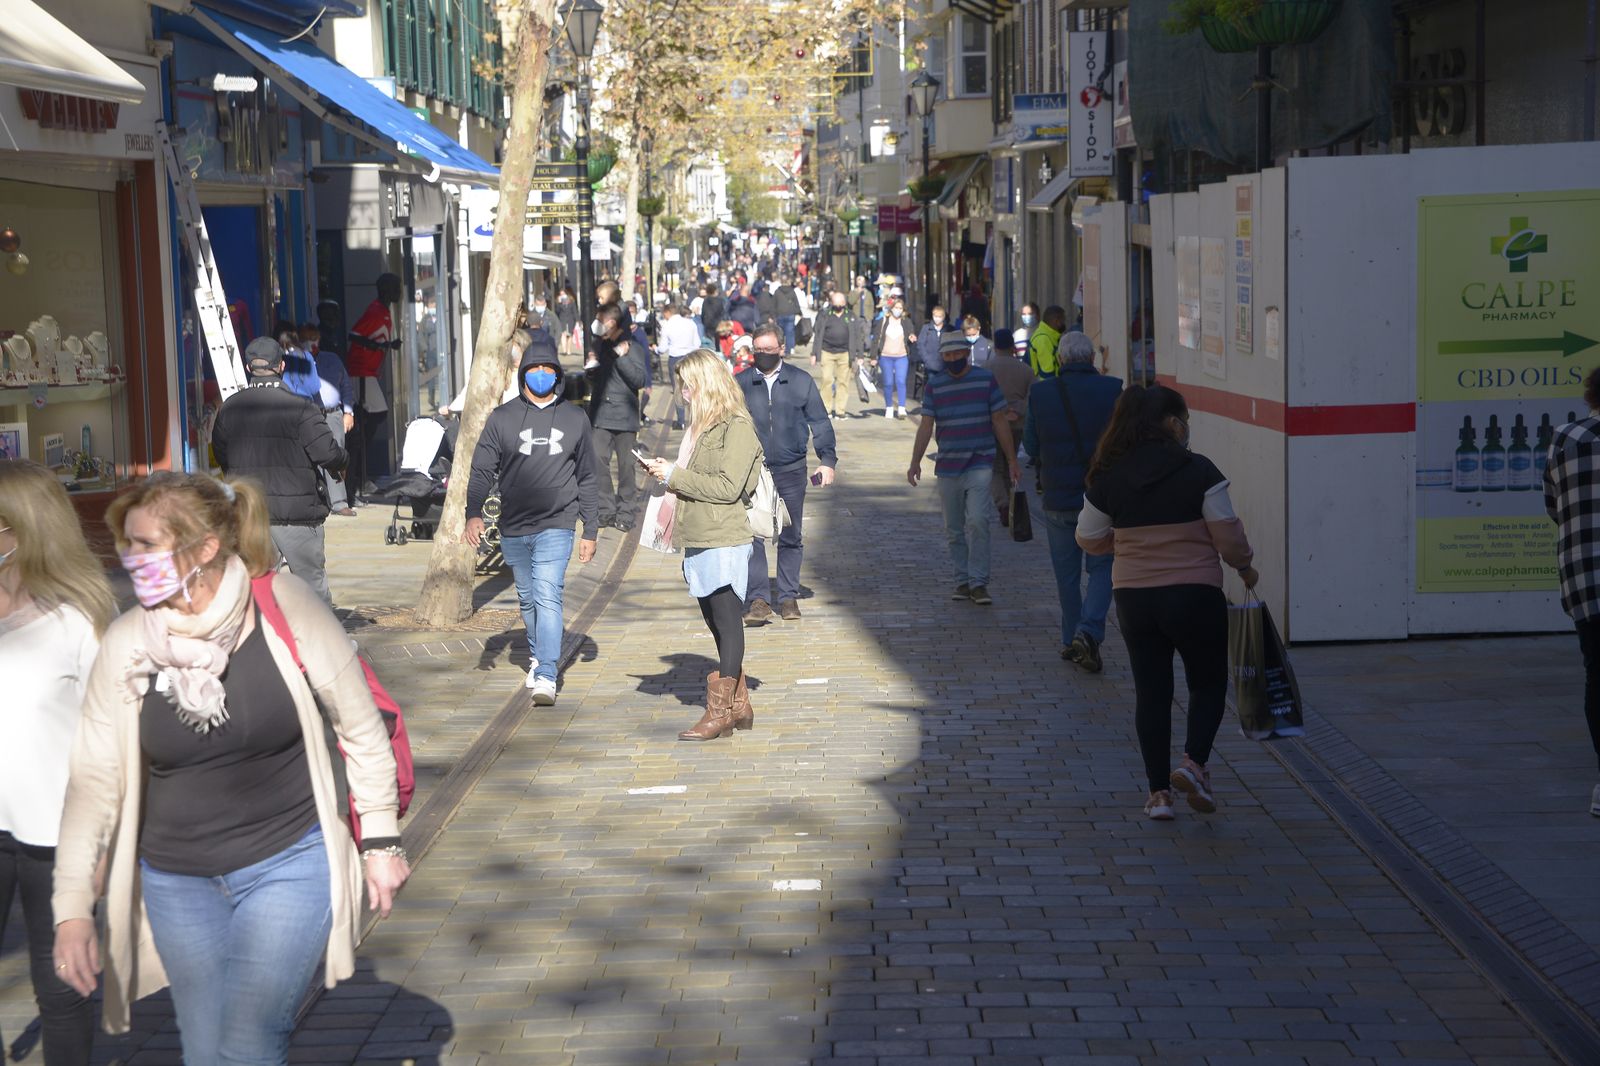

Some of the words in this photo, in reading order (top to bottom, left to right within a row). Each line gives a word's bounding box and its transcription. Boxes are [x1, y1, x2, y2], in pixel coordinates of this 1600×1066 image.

[1086, 37, 1096, 84] foot
[1032, 97, 1061, 109] EPM
[124, 133, 155, 155] JEWELLERS
[1086, 110, 1097, 162] stop
[1461, 280, 1576, 309] CALPE
[1482, 311, 1556, 322] PHARMACY
[1457, 367, 1515, 389] CBD
[1520, 366, 1582, 386] OILS
